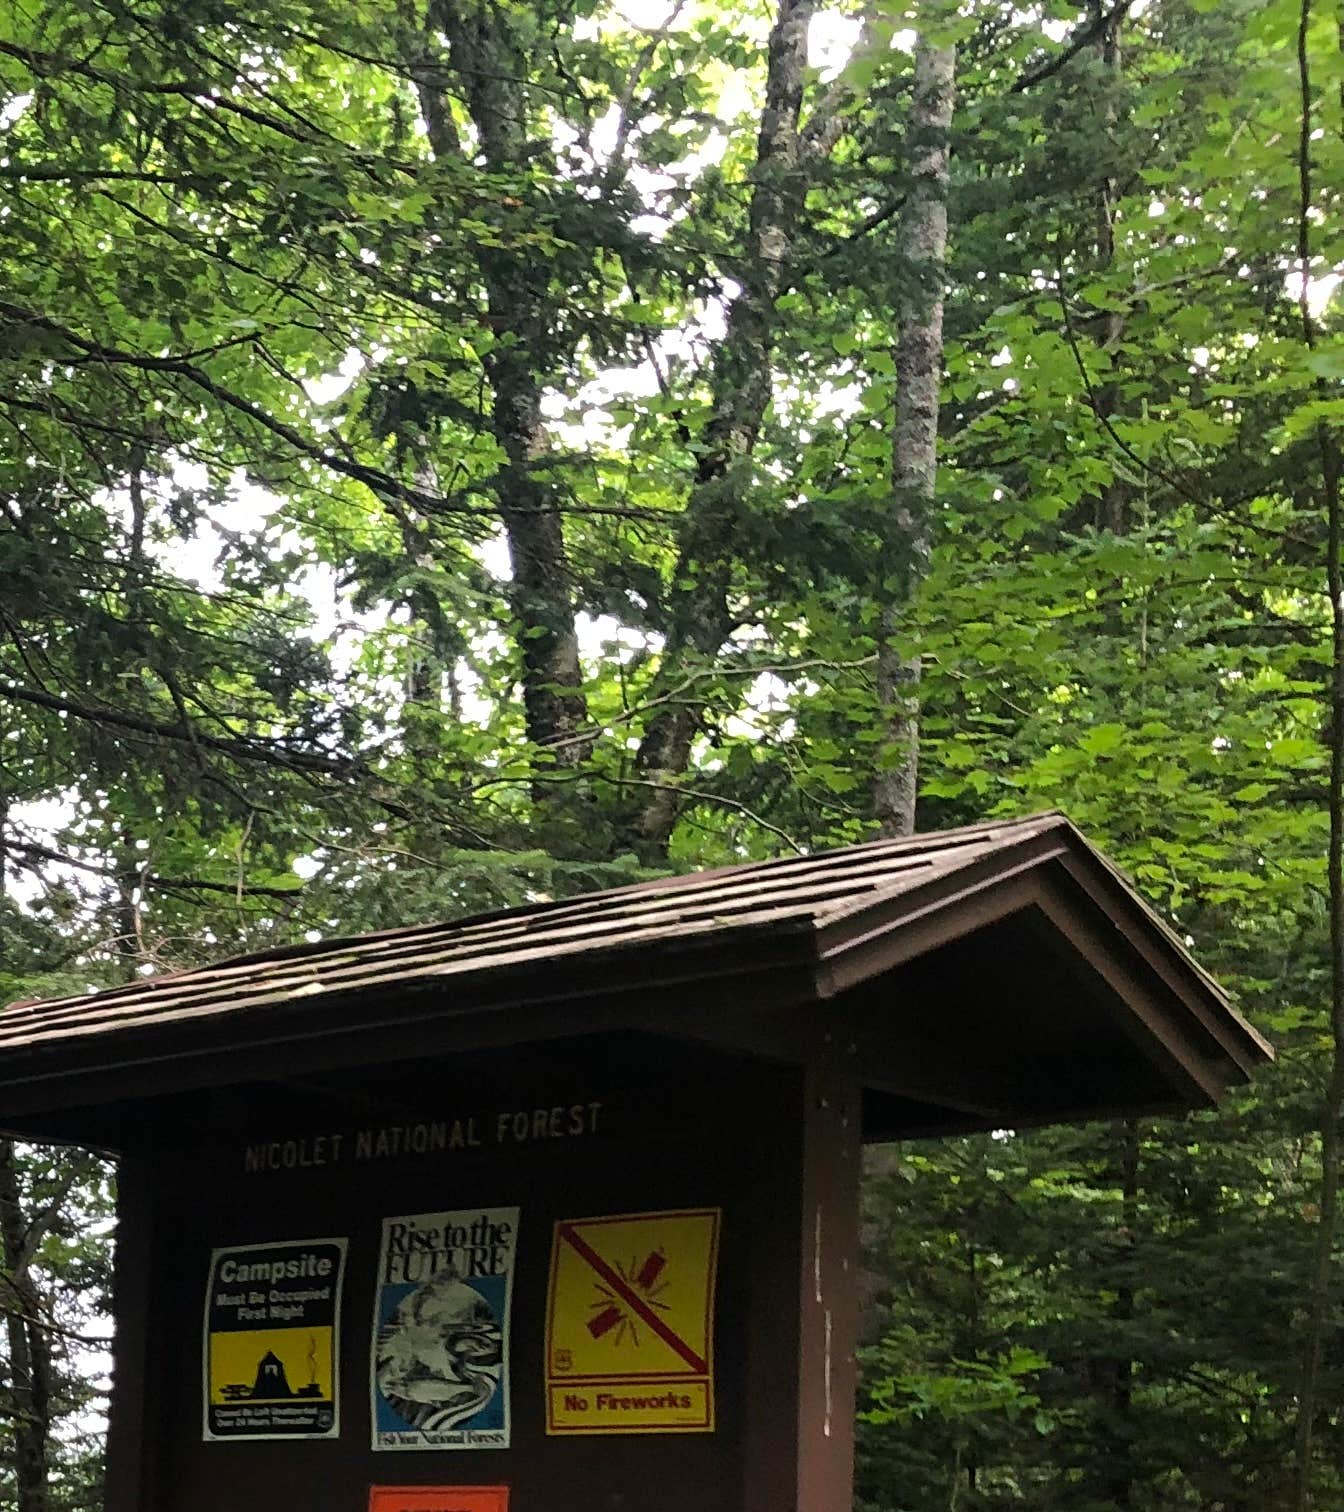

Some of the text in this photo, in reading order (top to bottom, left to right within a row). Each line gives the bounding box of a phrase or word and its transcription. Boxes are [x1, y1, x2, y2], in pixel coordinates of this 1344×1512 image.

[243, 1101, 603, 1172] NICOLET NATIONAL FOREST
[388, 1214, 512, 1253] Rise to the
[219, 1253, 332, 1285] Campsite
[385, 1245, 510, 1283] FUTURE
[237, 1307, 266, 1320] First
[563, 1391, 691, 1411] No Fireworks
